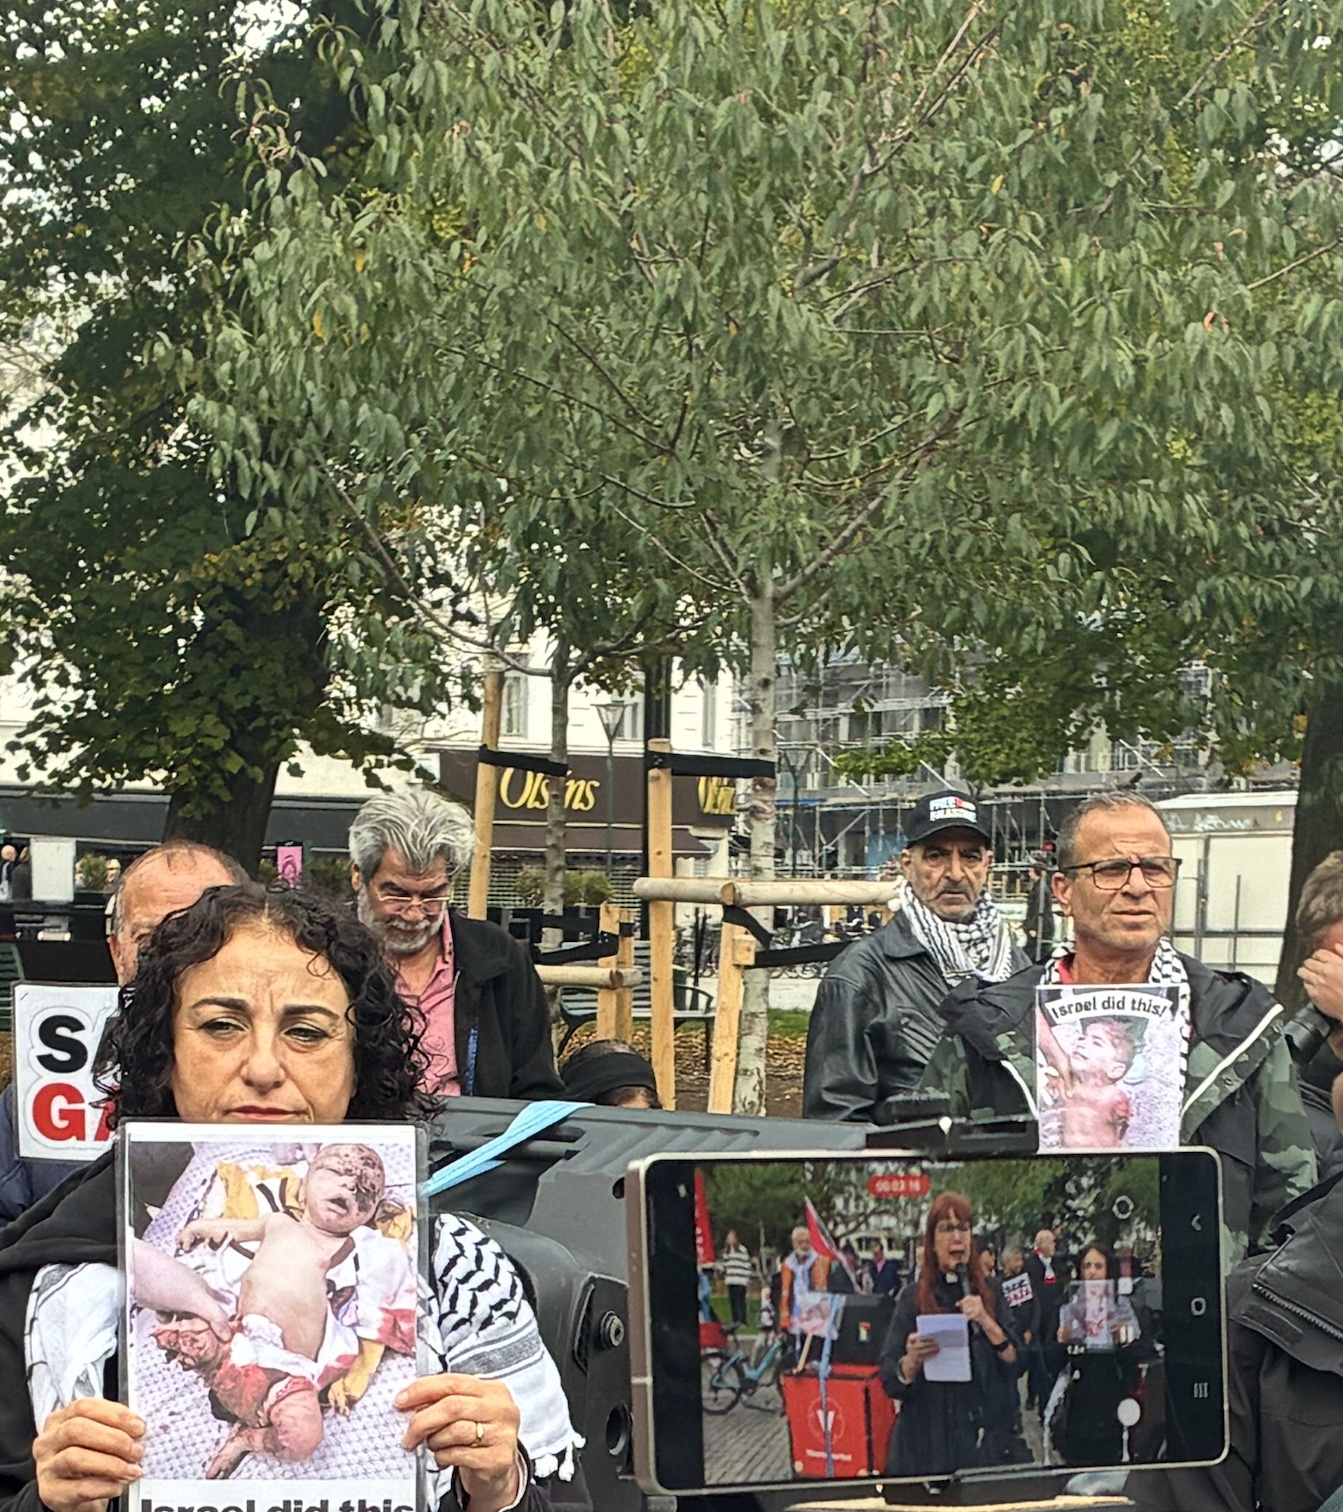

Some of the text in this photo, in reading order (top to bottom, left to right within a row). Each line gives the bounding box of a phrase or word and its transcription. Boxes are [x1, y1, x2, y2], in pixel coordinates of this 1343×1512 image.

[500, 767, 600, 811] Olsns
[1051, 996, 1167, 1020] Israel did this!
